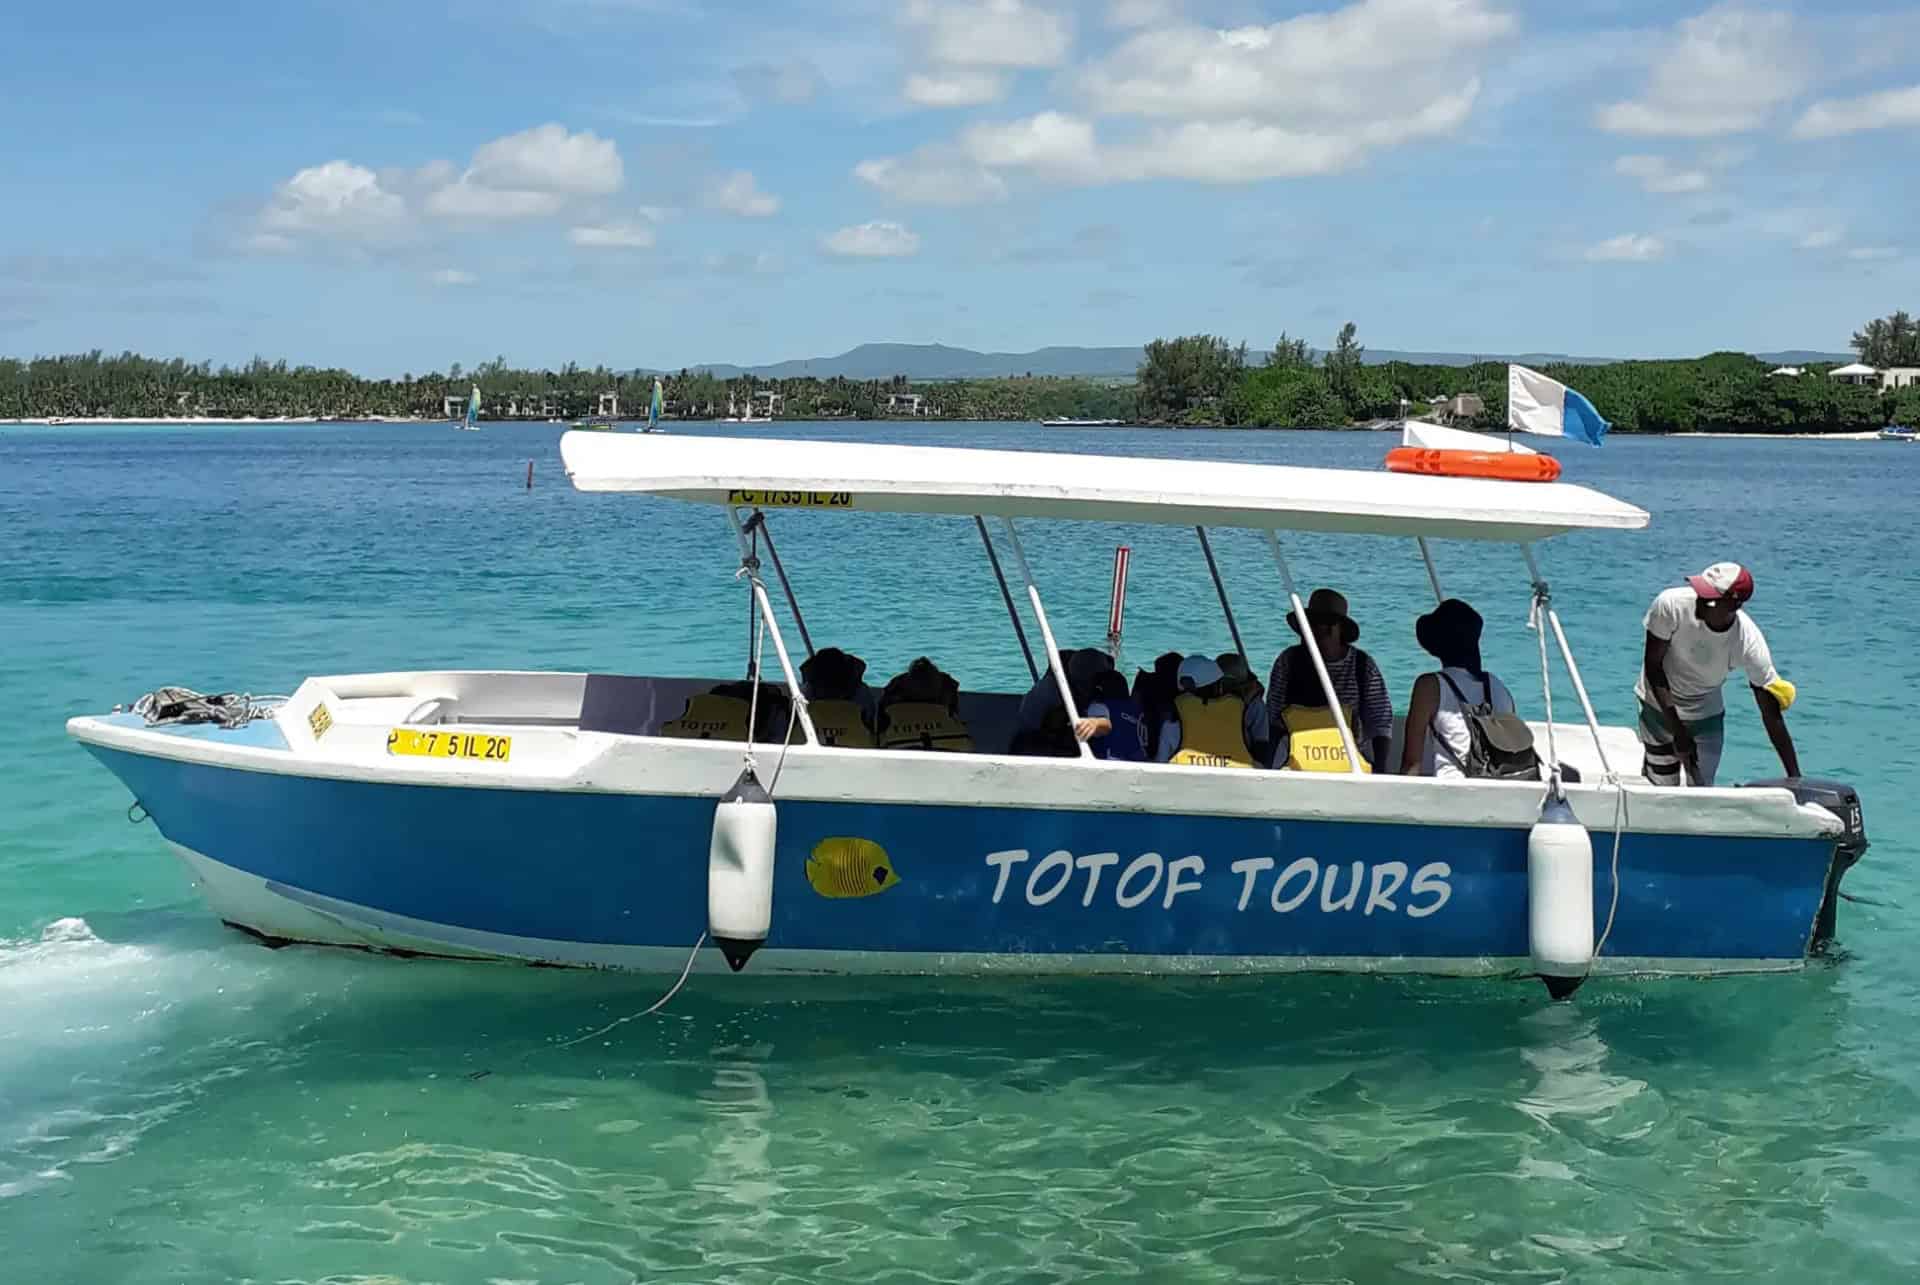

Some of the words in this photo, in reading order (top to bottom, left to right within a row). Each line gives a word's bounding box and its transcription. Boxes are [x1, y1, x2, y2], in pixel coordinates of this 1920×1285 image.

[464, 736, 479, 757] IL
[1303, 745, 1347, 761] TOTOF
[985, 849, 1205, 909] TOTOF
[1231, 857, 1452, 918] TOURS
